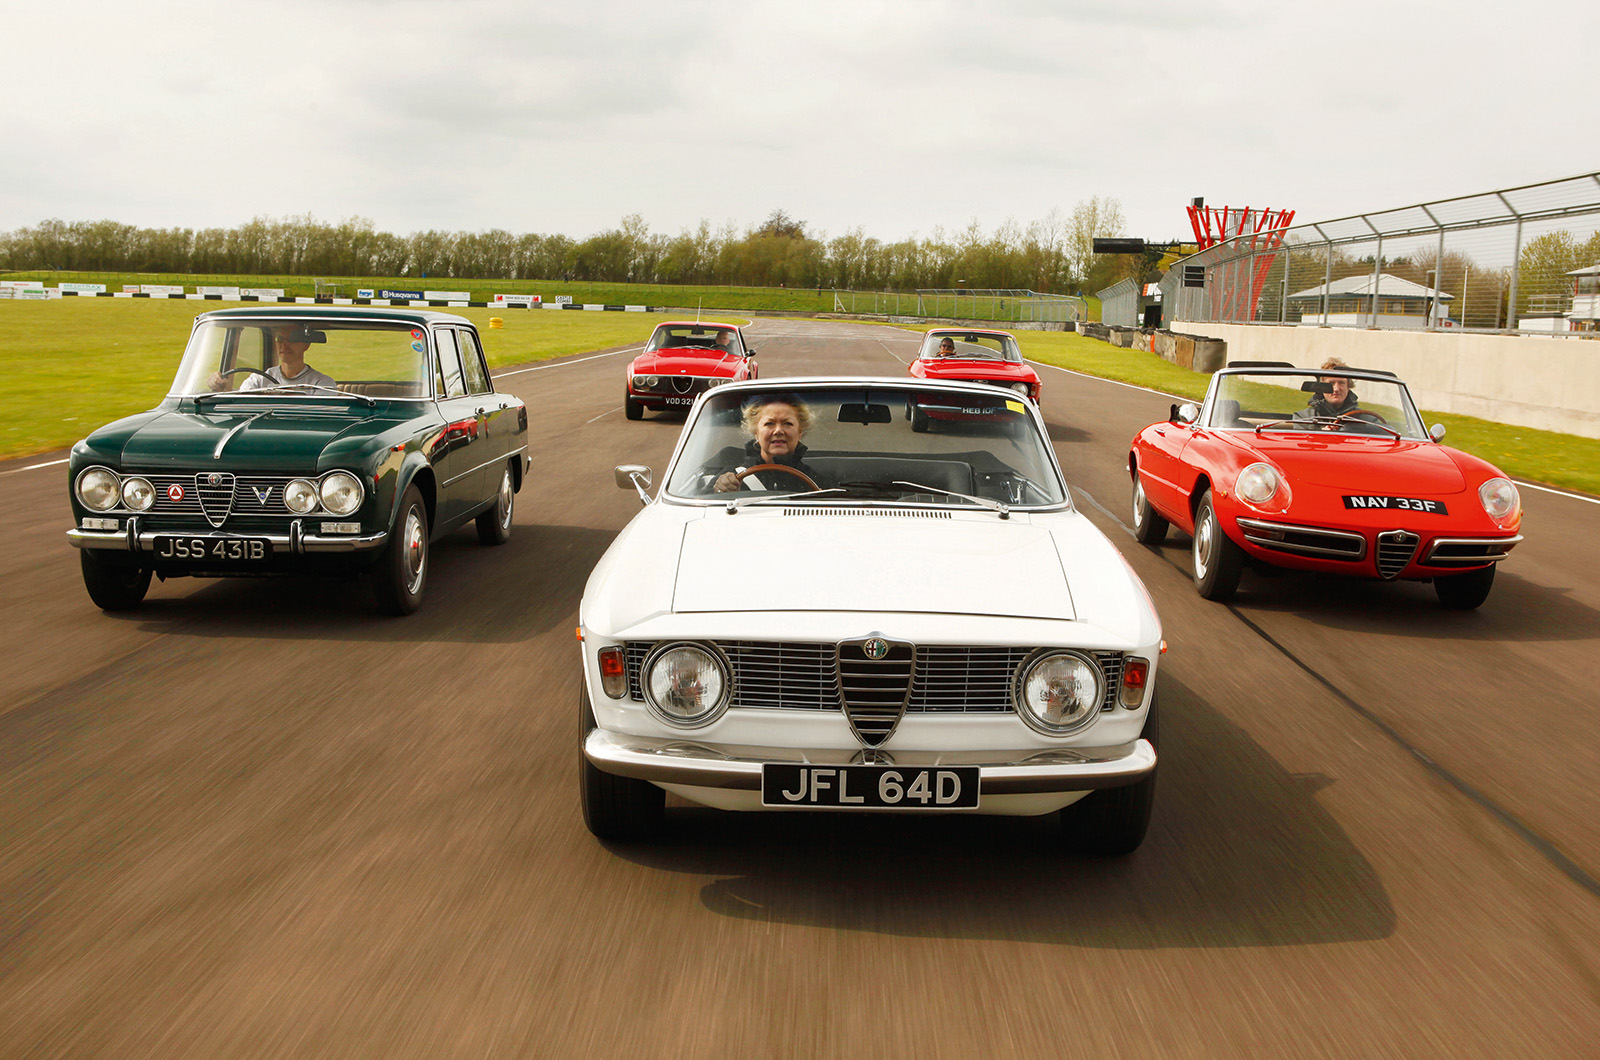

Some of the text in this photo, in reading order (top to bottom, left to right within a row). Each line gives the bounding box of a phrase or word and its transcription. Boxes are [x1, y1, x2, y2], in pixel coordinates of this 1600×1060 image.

[388, 291, 420, 299] Husqvarna
[1350, 496, 1436, 512] NAV 33F
[160, 538, 265, 560] JSS 431B
[782, 768, 962, 804] JFL 64D
